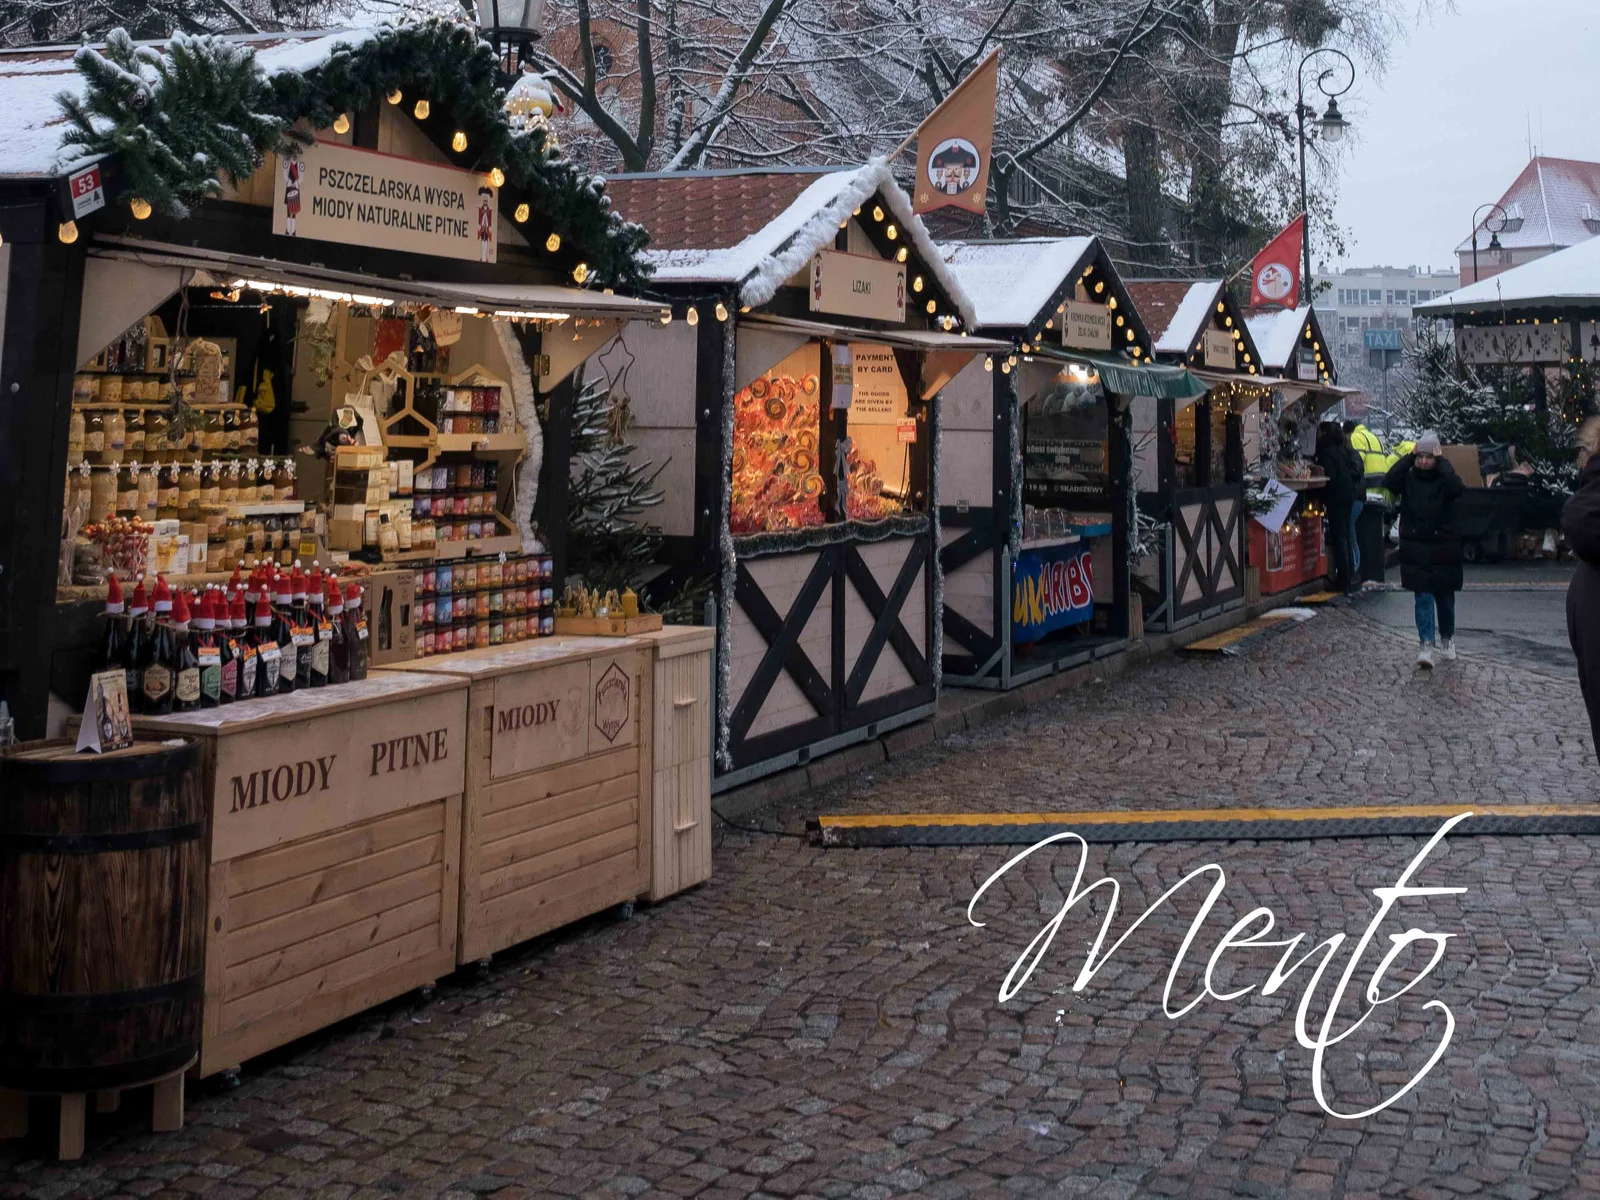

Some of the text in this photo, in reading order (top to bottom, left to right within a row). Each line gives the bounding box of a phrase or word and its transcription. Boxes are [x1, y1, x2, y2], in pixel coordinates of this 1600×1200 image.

[78, 174, 95, 193] 53
[319, 167, 465, 210] PSZCZELARSKA WYSPA
[312, 196, 469, 238] MIODY NATURALNE PITNE
[1365, 332, 1398, 347] TAXI
[497, 699, 561, 734] MIODY
[228, 728, 449, 814] MIODY PITNE
